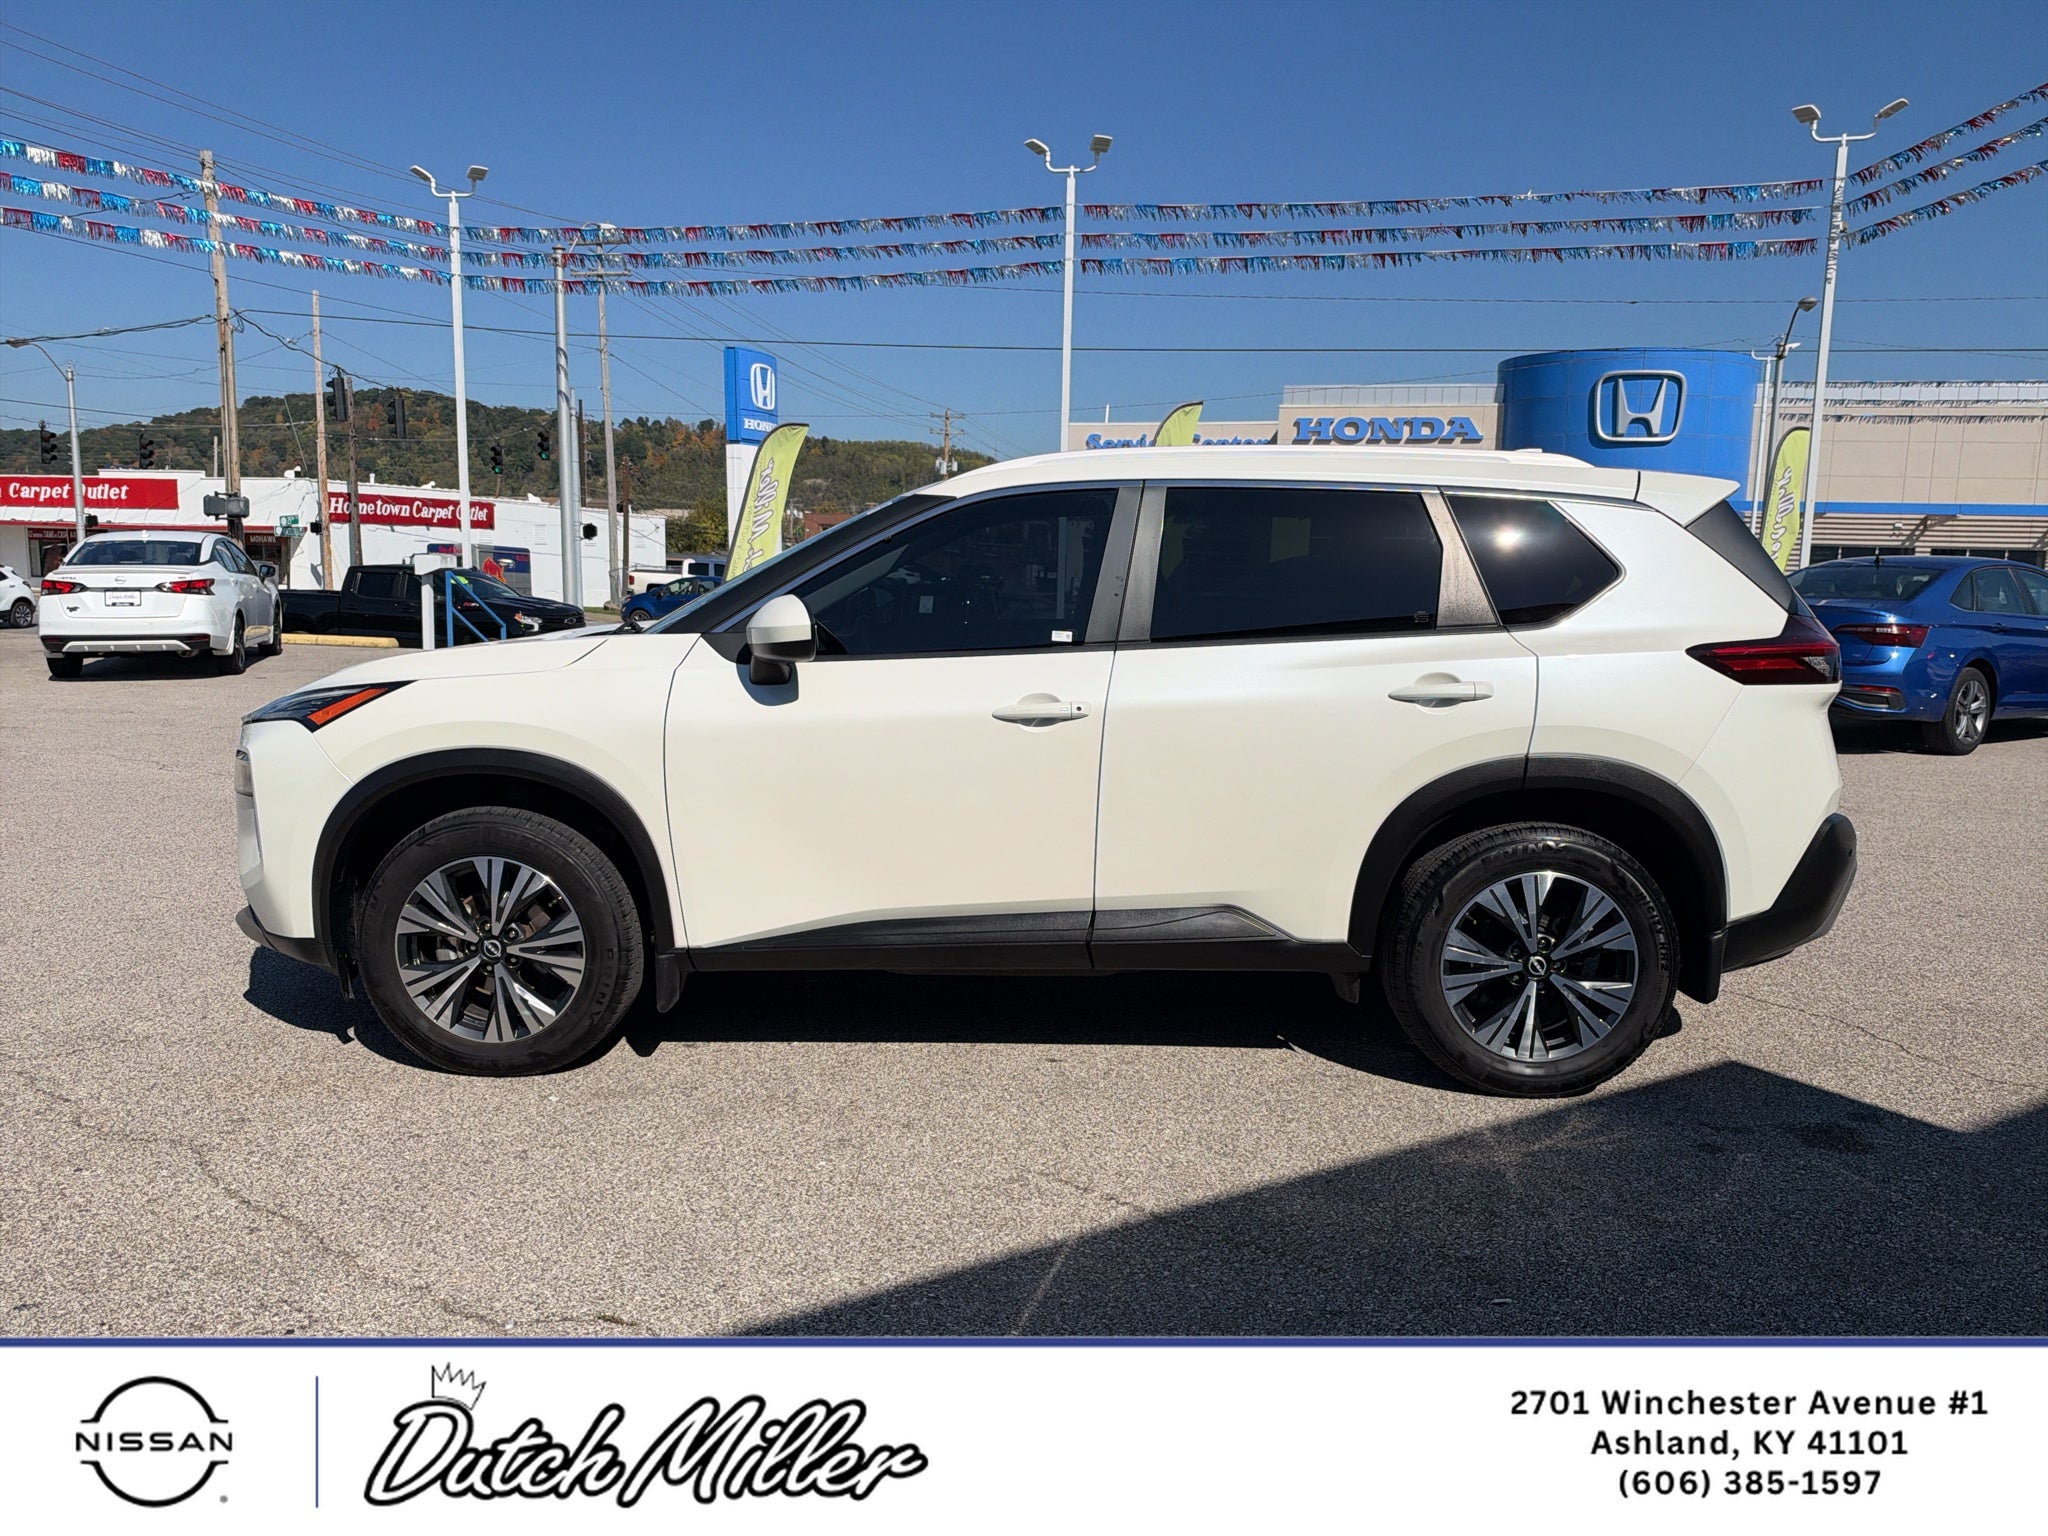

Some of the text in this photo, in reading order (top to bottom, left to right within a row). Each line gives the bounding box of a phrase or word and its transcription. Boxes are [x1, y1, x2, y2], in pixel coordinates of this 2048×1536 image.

[1292, 416, 1484, 445] HONDA
[9, 482, 71, 502] Carpet
[413, 500, 453, 523] Carpet
[250, 535, 276, 543] MOHAWK
